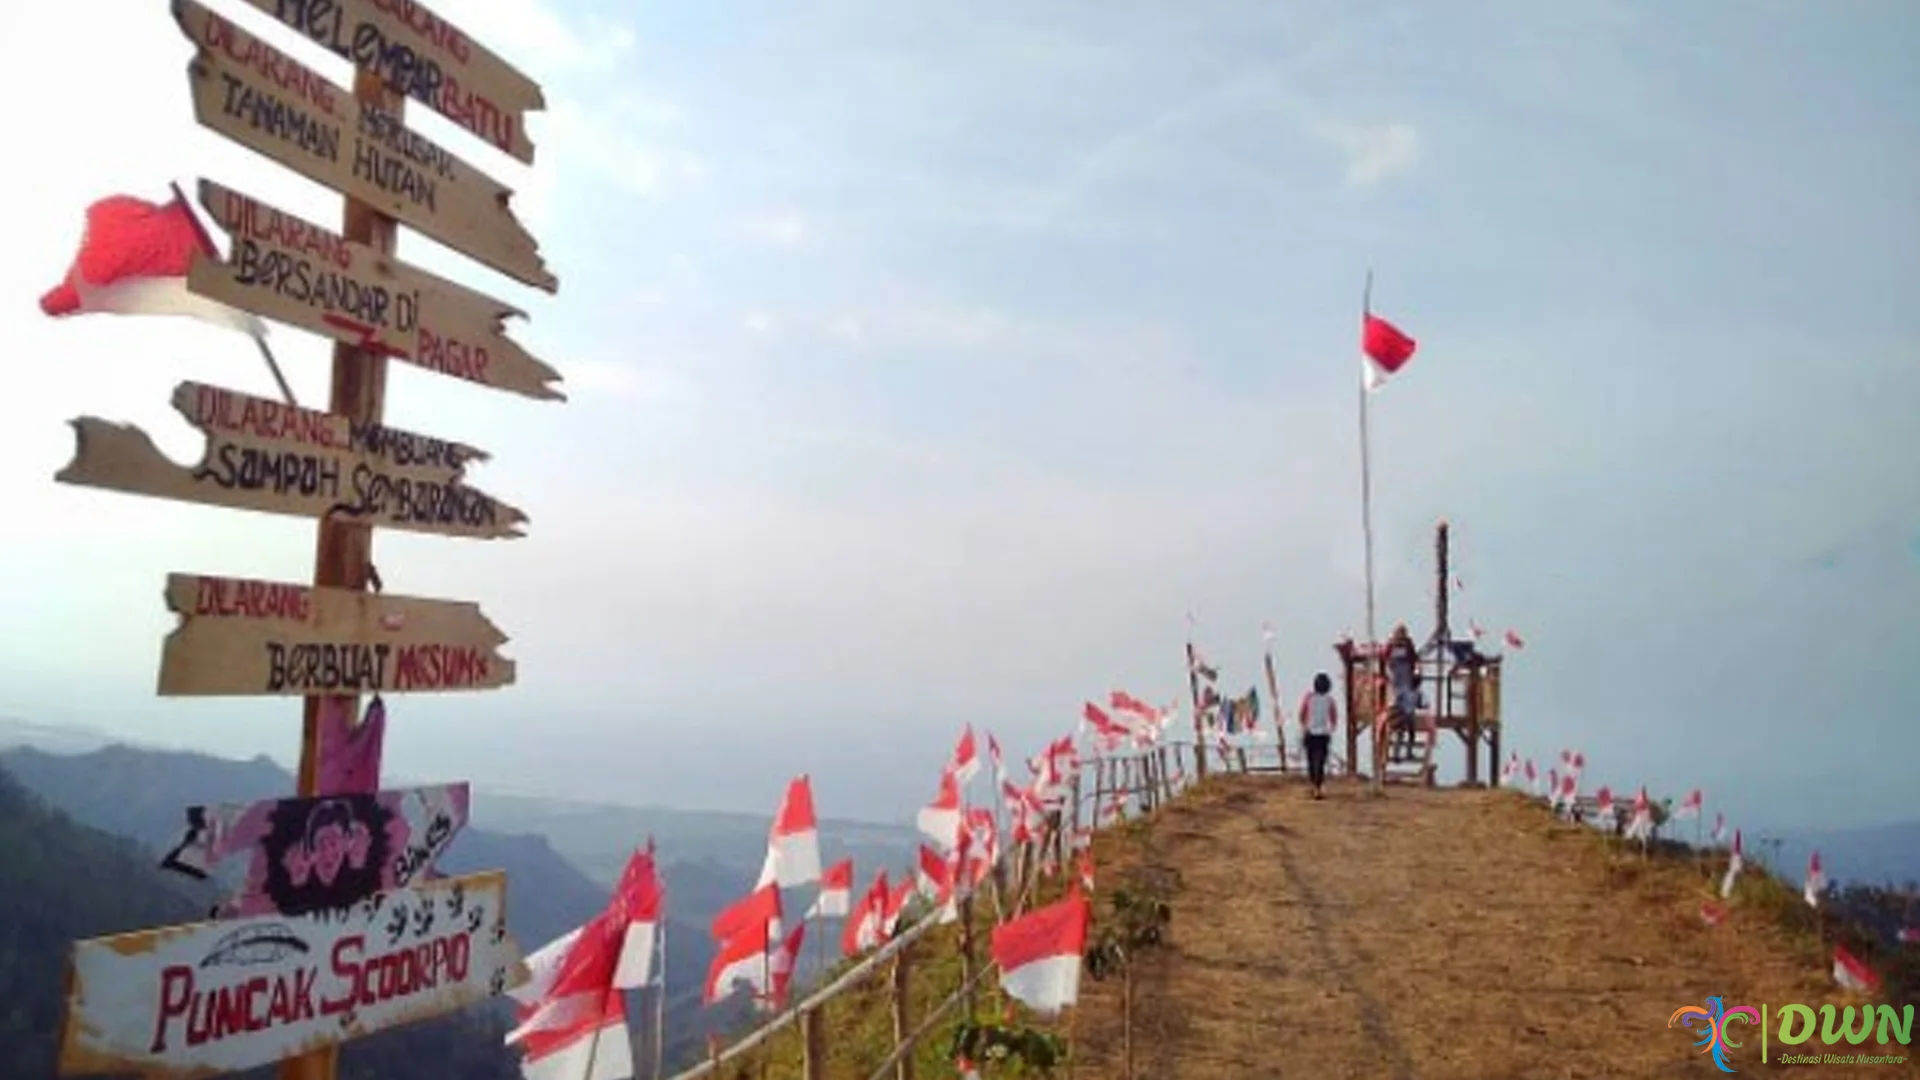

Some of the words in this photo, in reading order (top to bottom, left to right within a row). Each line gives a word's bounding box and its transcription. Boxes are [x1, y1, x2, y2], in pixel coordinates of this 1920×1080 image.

[221, 72, 340, 164] TANAMAN
[352, 137, 436, 215] HUTAN
[416, 327, 490, 384] PAGAR
[197, 386, 336, 447] DILARANG
[196, 577, 310, 622] DILARANG
